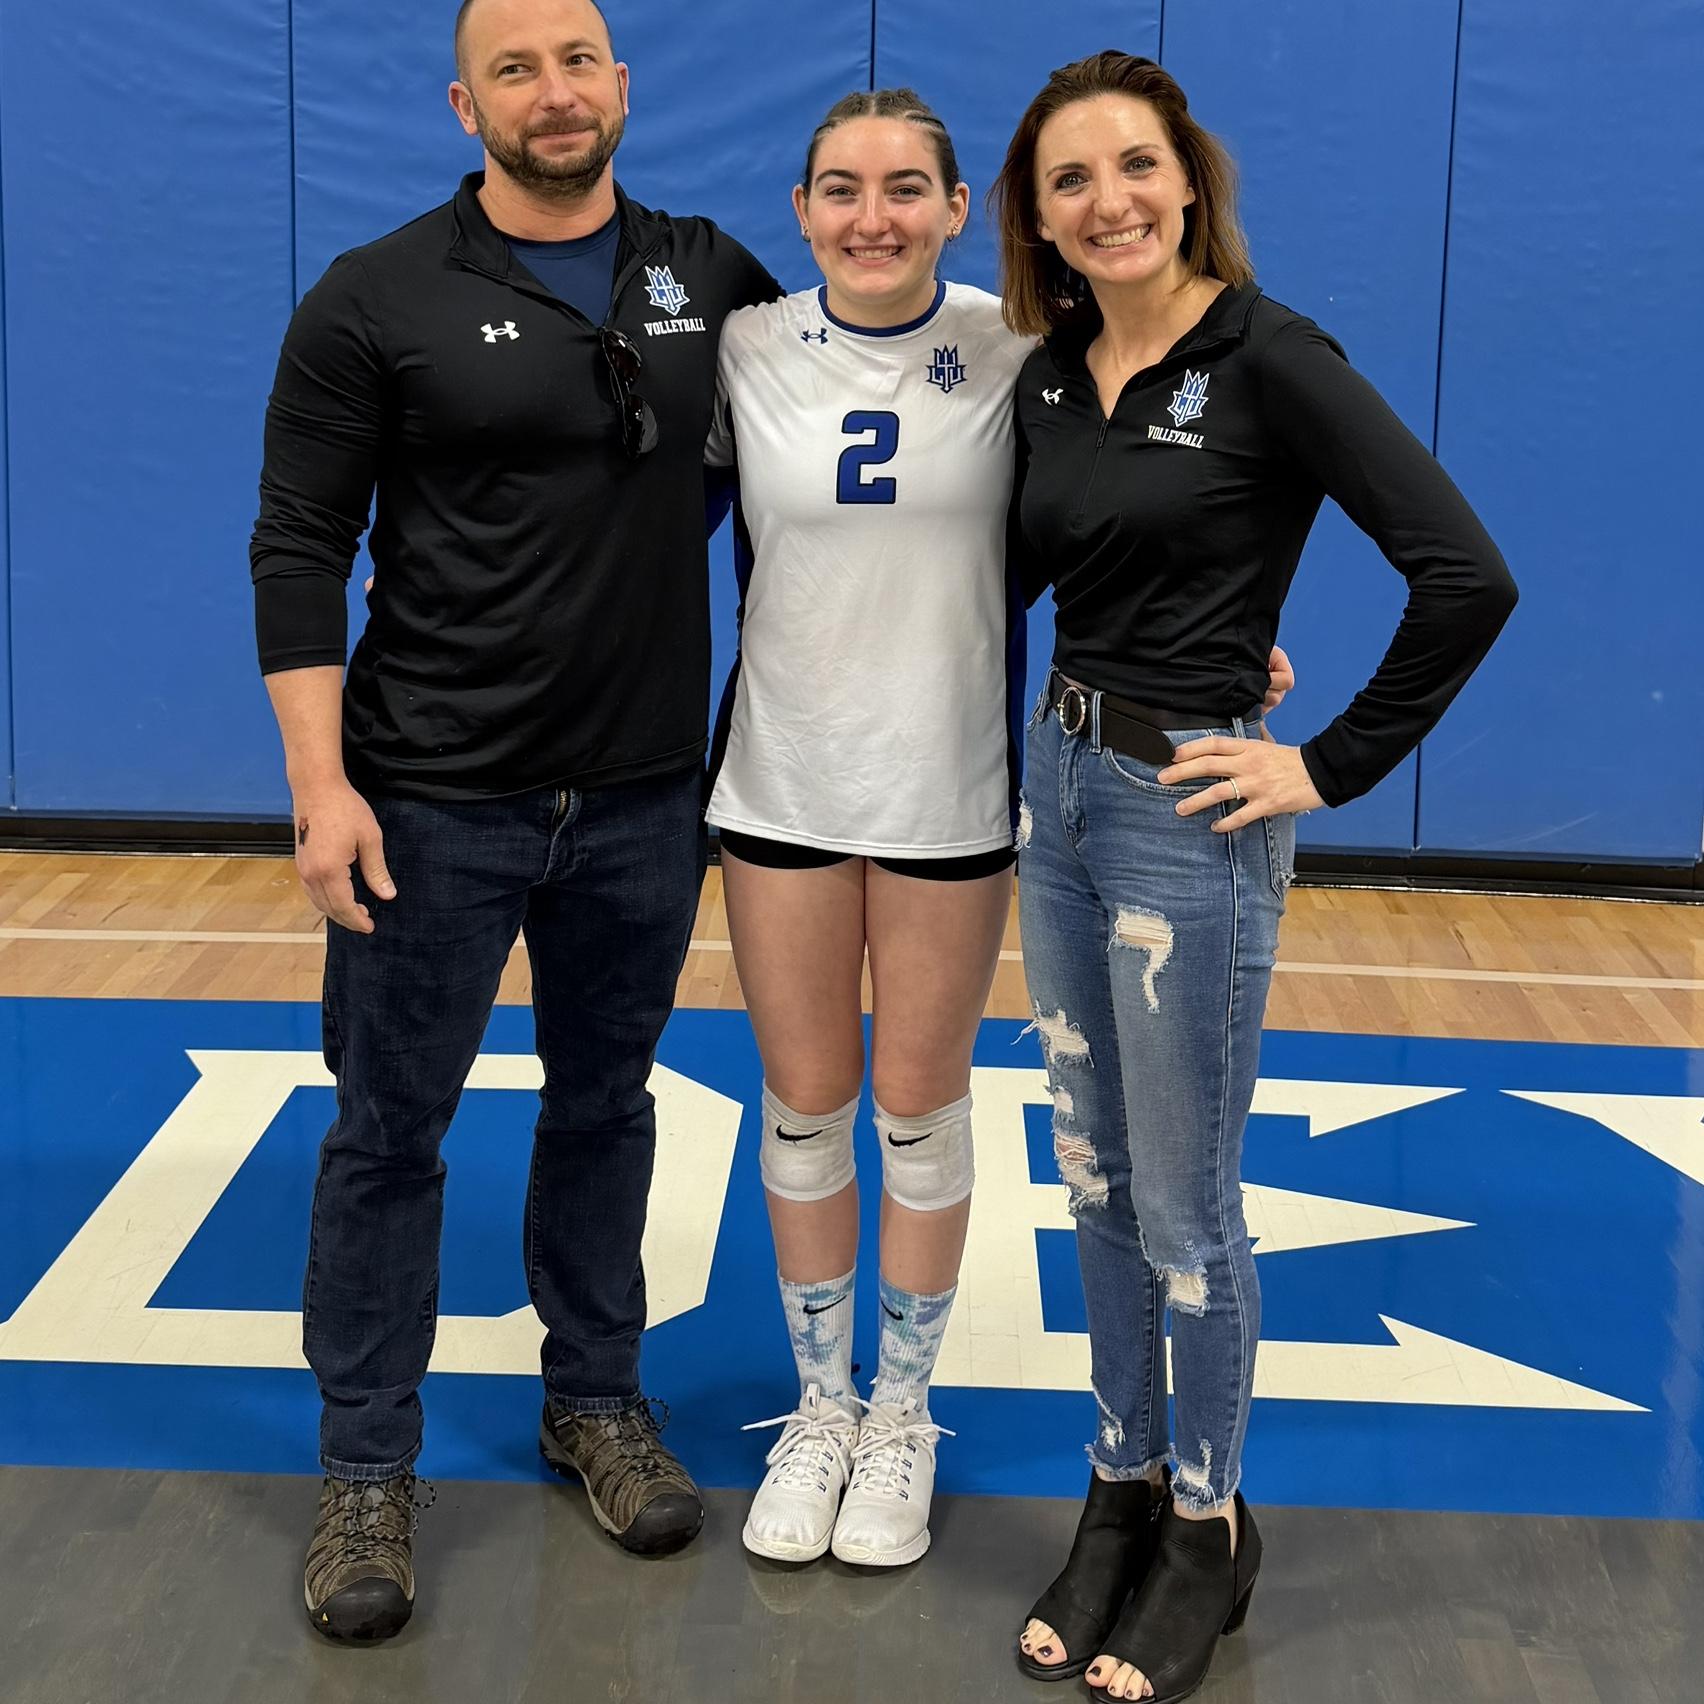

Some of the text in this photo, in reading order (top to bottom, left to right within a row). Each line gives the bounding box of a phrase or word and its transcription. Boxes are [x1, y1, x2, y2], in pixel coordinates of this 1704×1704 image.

[644, 318, 706, 336] VOLLEYBALL
[1147, 425, 1204, 448] VOLLEYBALL
[836, 410, 900, 504] 2
